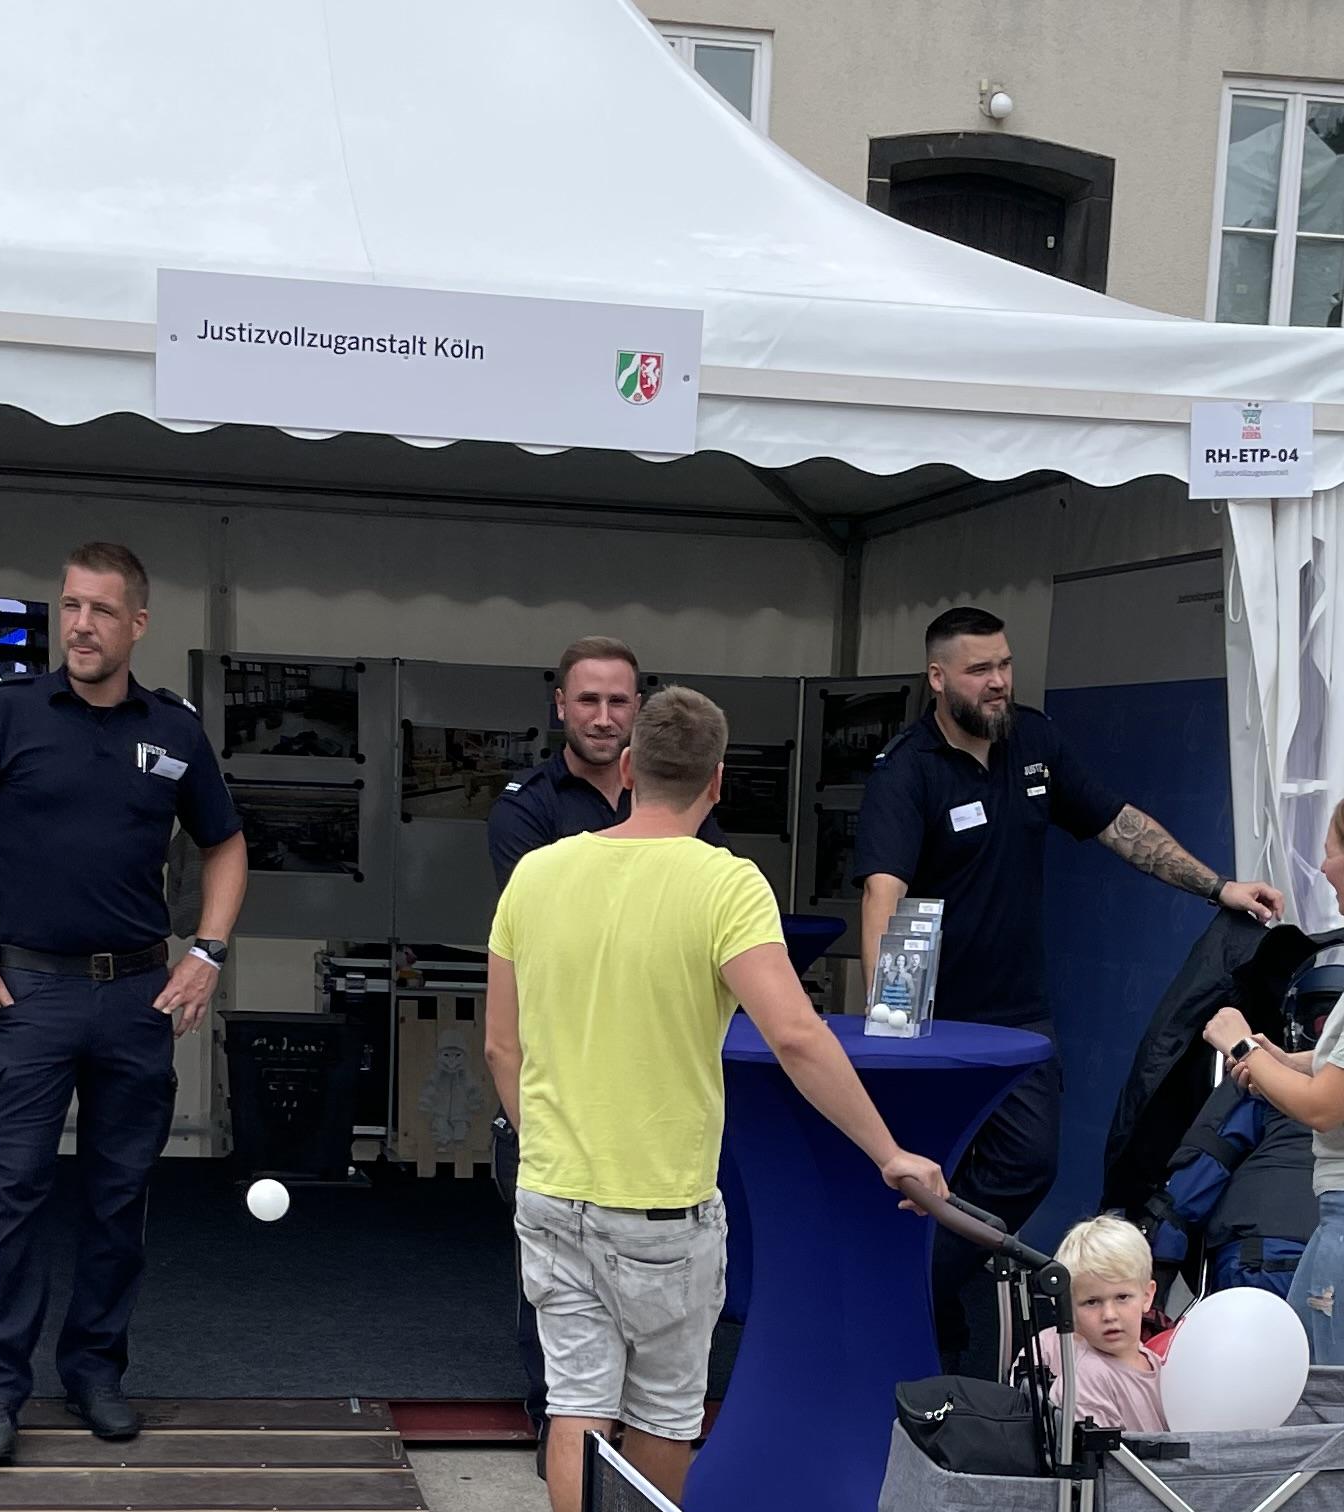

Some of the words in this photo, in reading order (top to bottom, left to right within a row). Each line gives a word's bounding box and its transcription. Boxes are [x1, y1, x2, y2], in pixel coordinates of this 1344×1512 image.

[197, 318, 427, 356] Justizvollzuganstalt
[434, 336, 485, 360] Köln
[1205, 448, 1299, 463] RH-ETP-04
